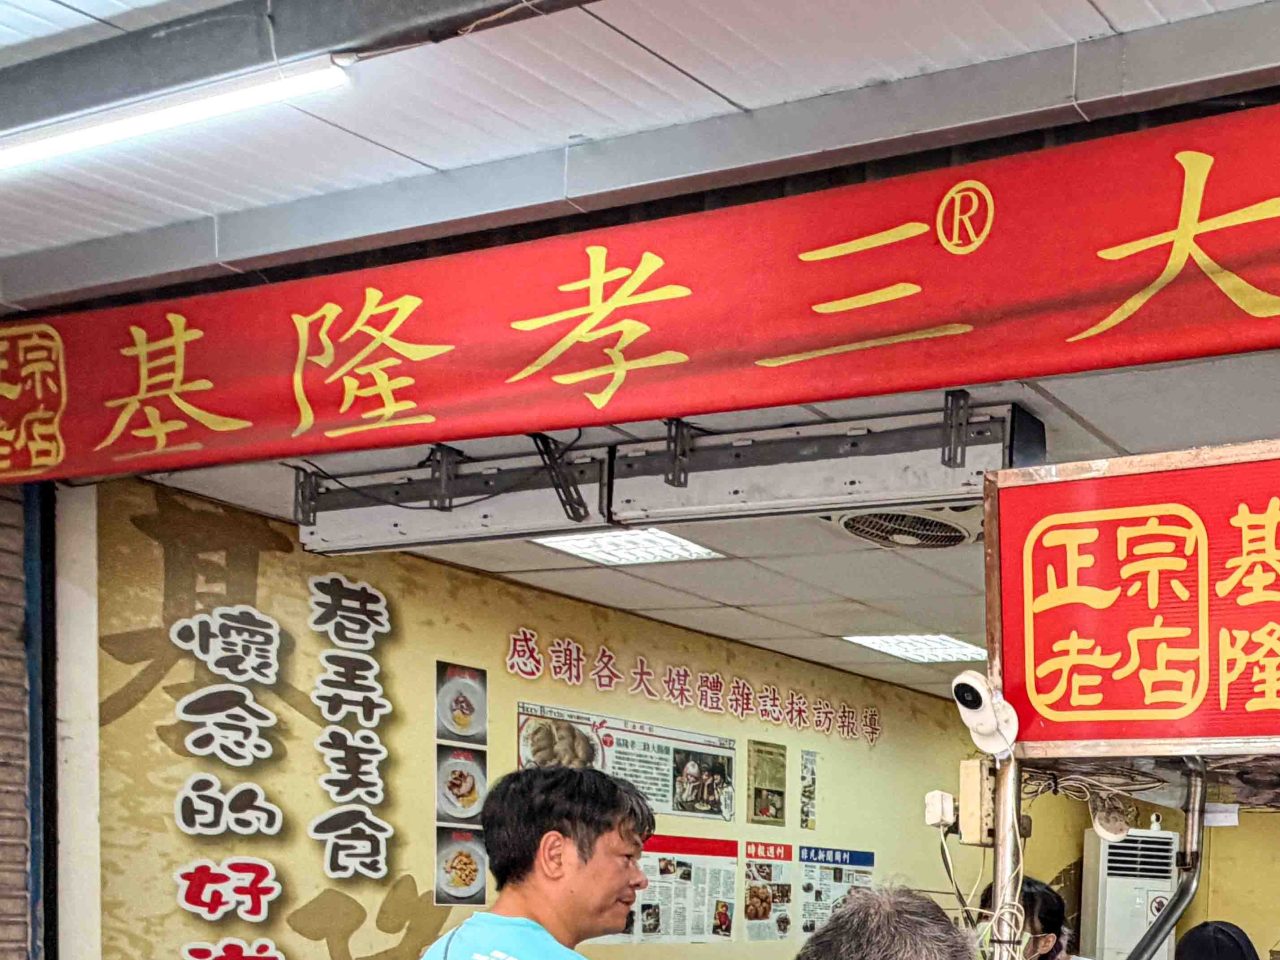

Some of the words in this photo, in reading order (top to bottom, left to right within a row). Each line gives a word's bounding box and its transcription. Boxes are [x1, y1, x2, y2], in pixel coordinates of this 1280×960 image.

[310, 572, 393, 879] 巷弄美食
[507, 628, 882, 746] 感謝各大媒體雜誌採訪報導
